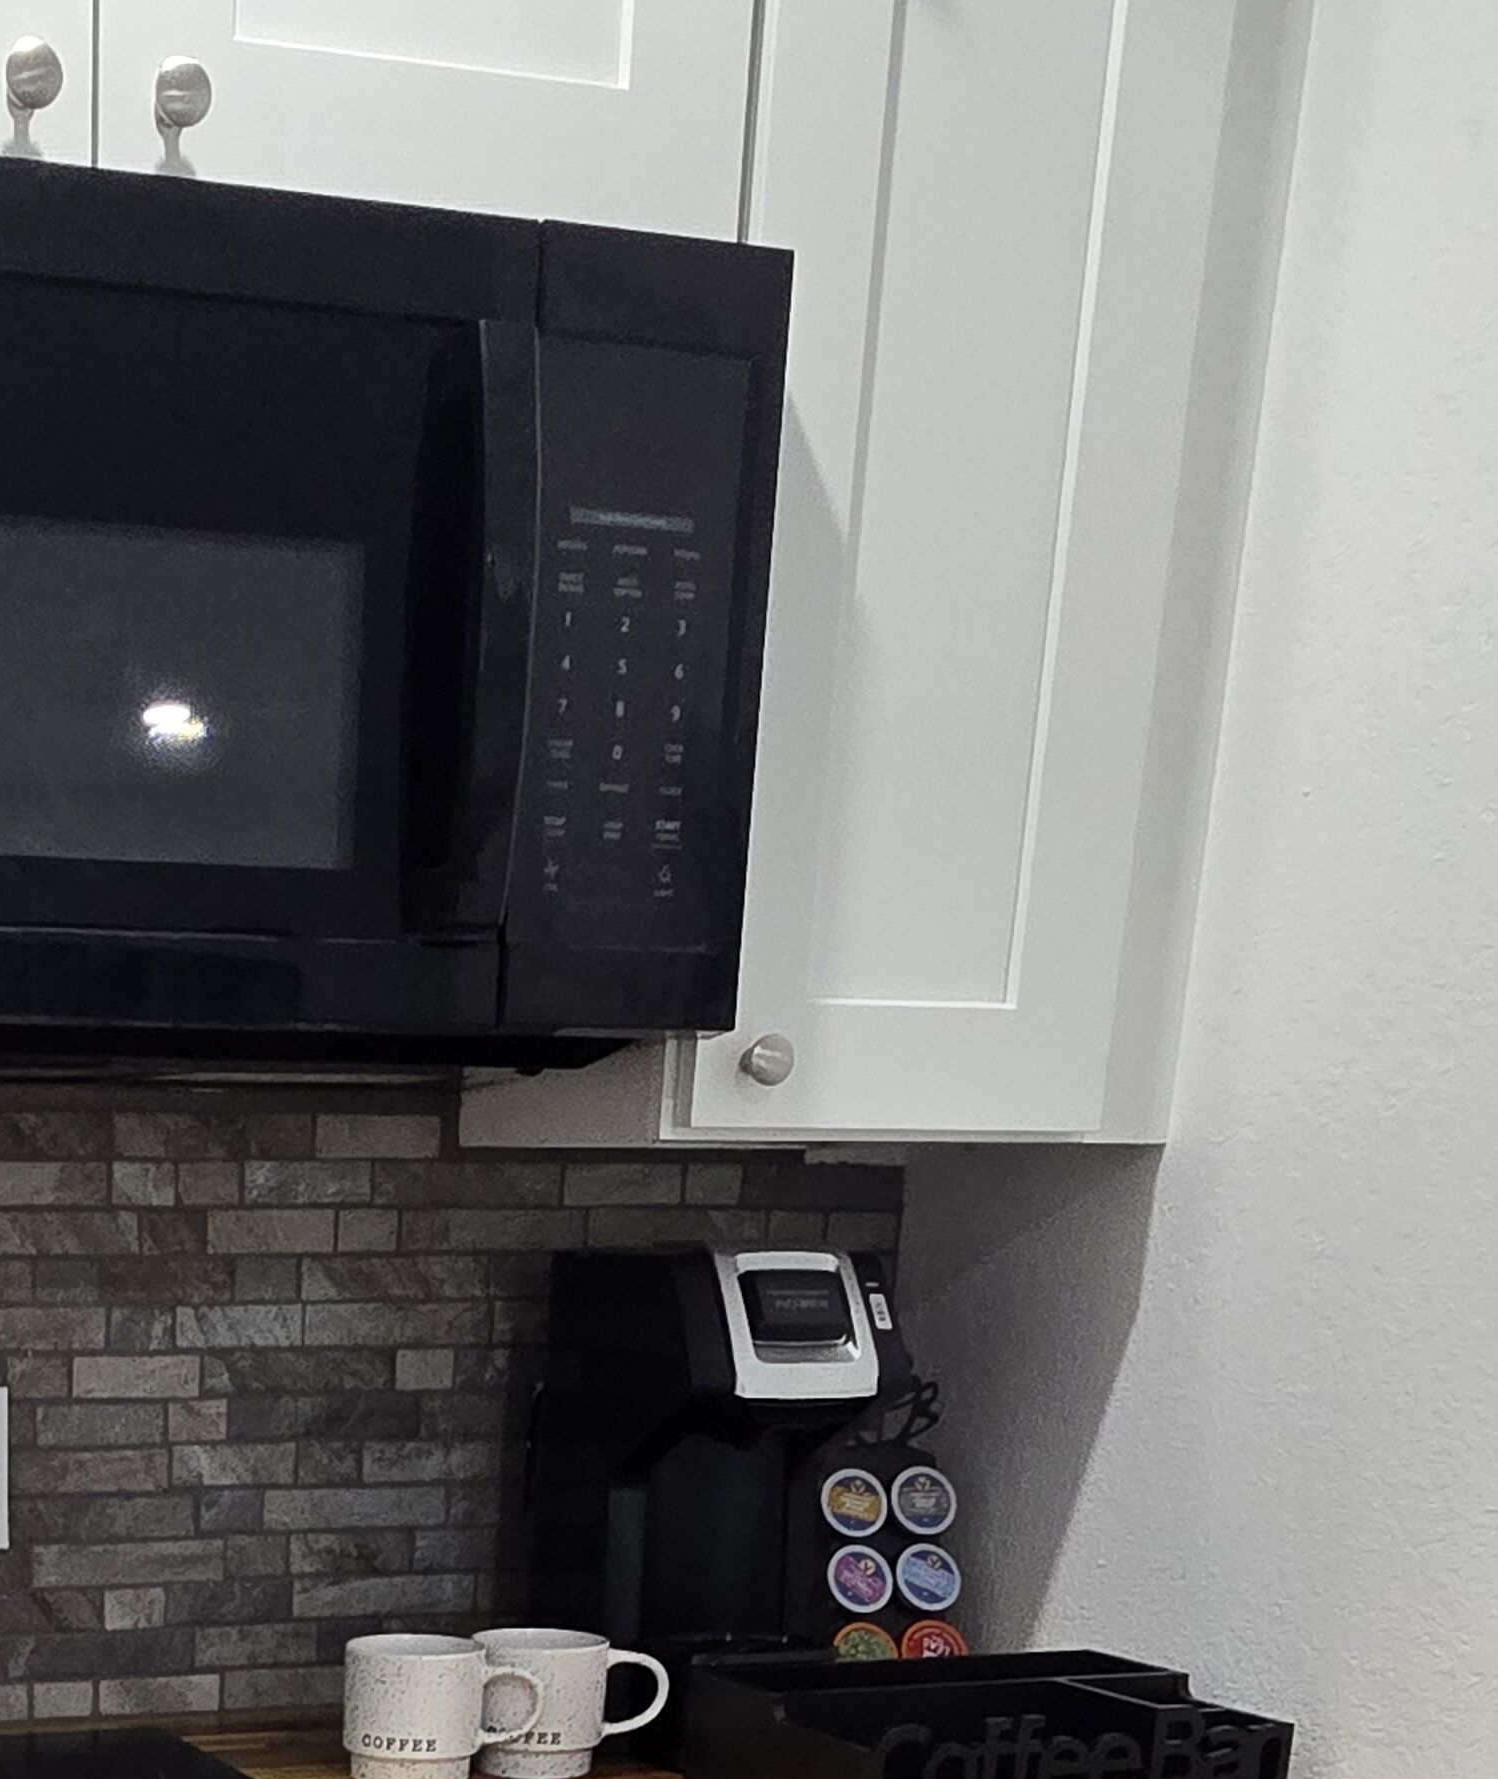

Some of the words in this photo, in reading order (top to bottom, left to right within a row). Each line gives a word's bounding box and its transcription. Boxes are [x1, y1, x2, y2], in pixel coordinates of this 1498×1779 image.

[620, 617, 630, 633] 2
[677, 619, 687, 636] 3
[561, 655, 570, 671] 4
[617, 658, 627, 675] 5
[674, 663, 684, 680] 6
[558, 698, 568, 714] 7
[615, 700, 625, 718] 8
[670, 705, 681, 722] 9
[612, 744, 623, 760] 0
[361, 1733, 438, 1753] COFFEE
